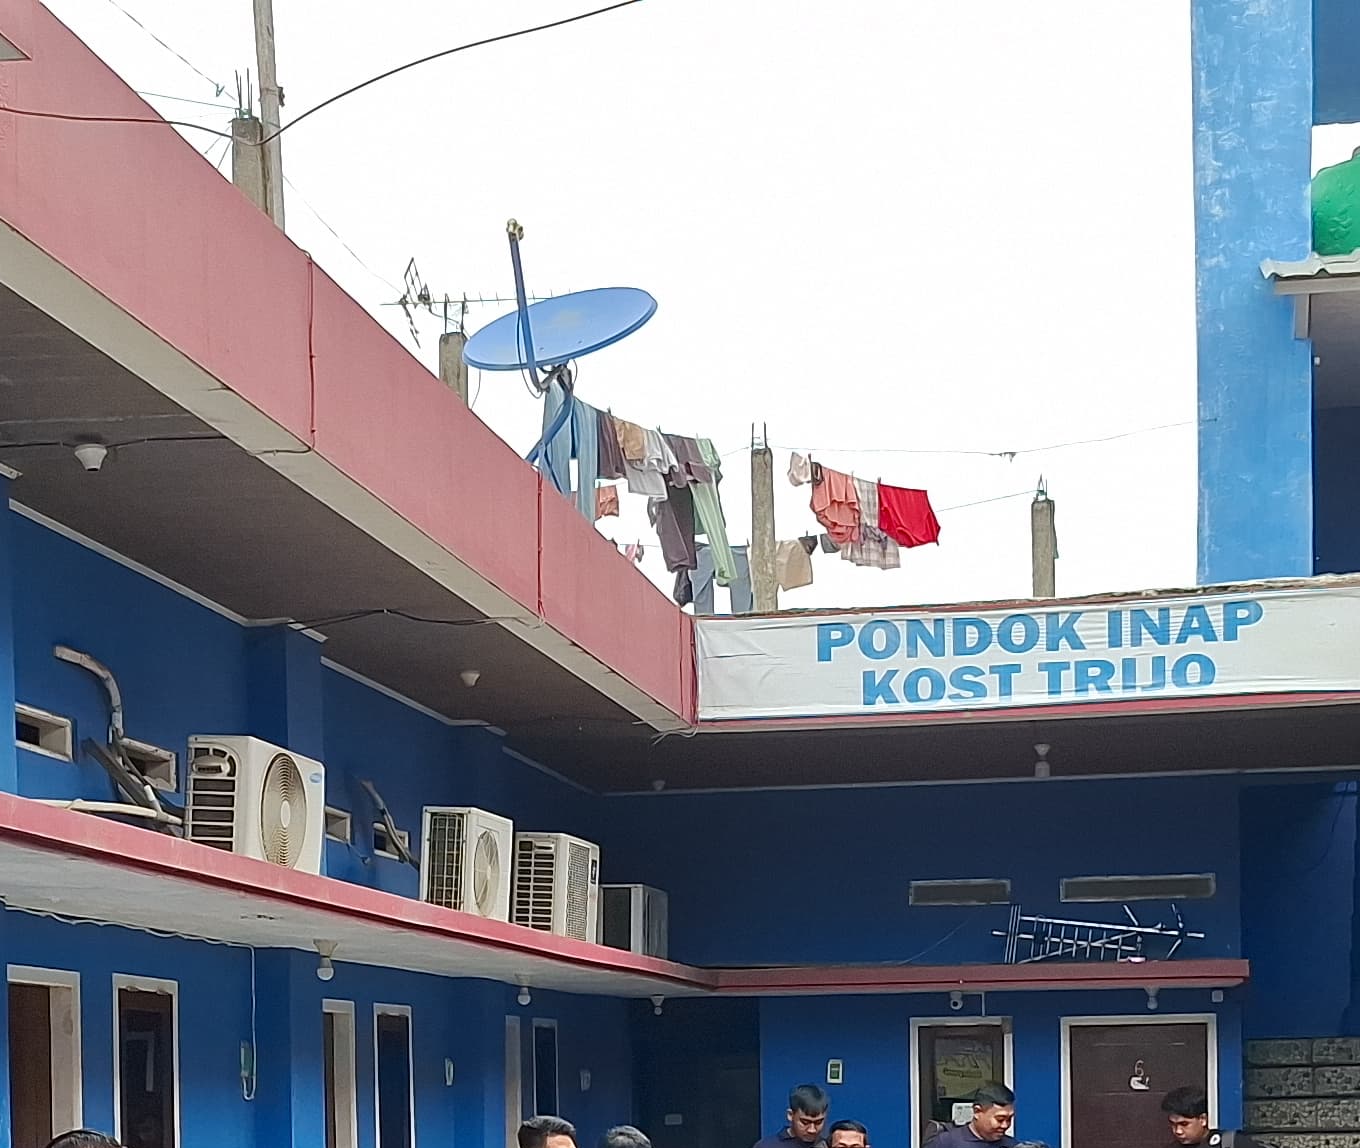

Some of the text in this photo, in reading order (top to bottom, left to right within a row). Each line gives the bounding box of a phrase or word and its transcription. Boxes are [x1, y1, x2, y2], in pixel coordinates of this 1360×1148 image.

[817, 600, 1265, 663] PONDOK INAP
[862, 653, 1217, 706] KOST TRIJO
